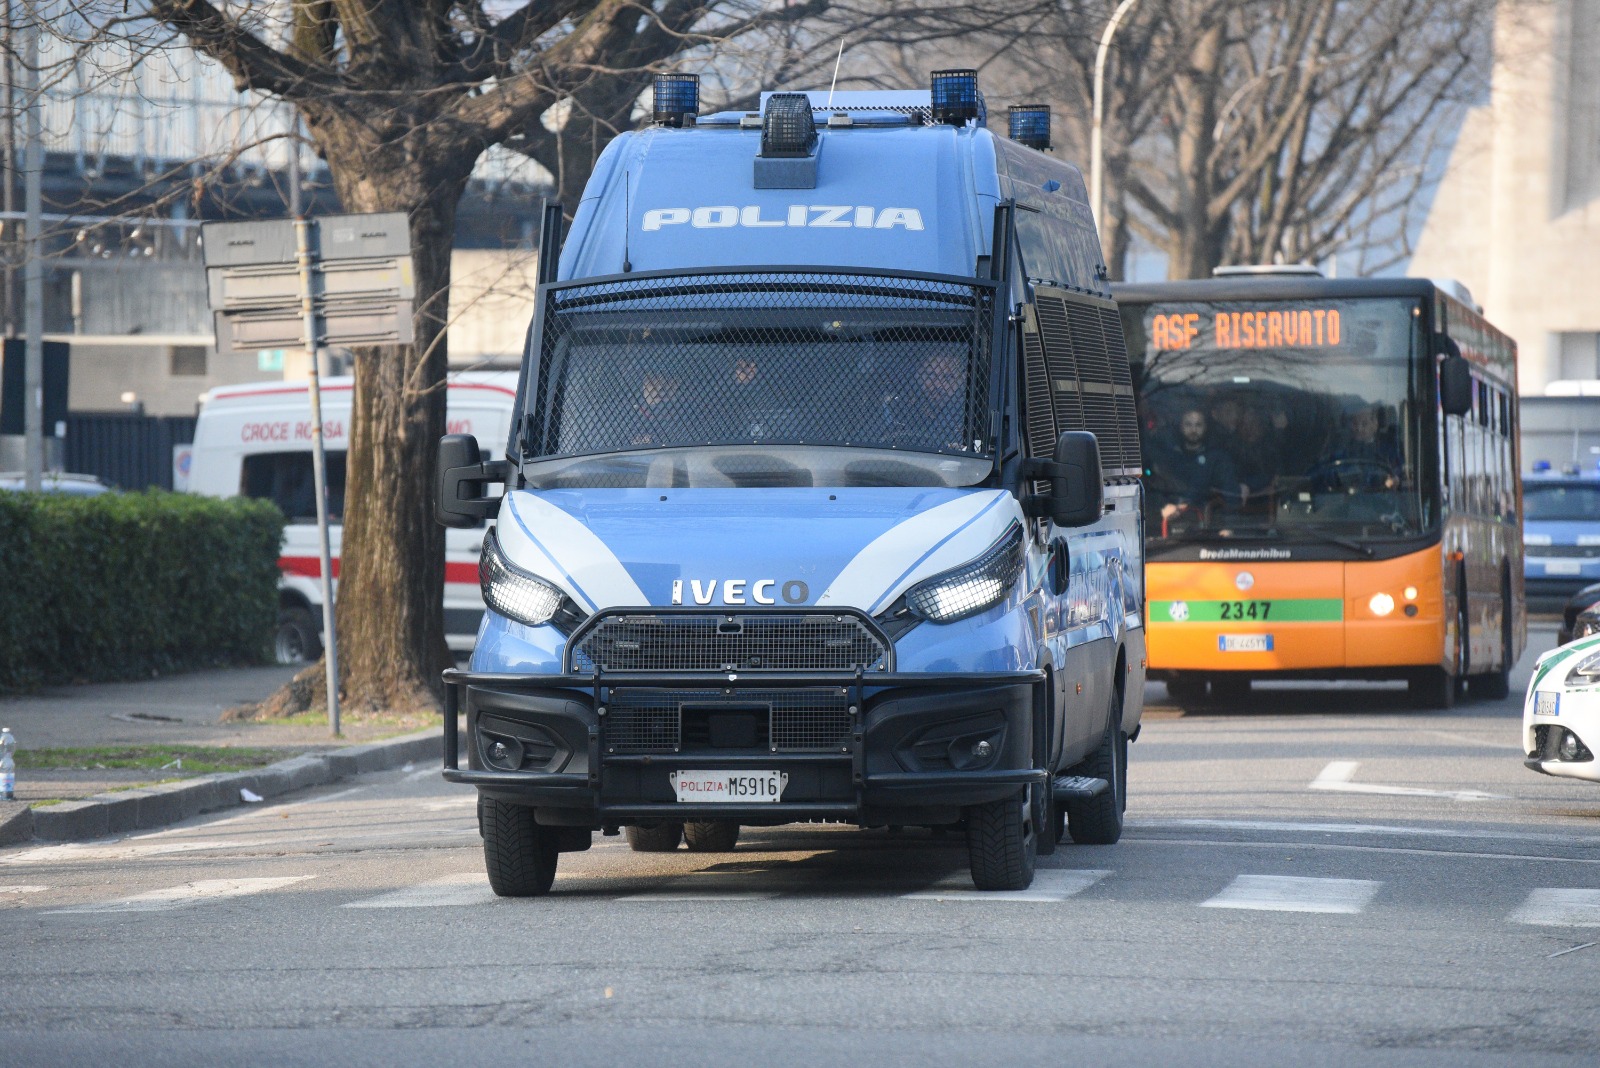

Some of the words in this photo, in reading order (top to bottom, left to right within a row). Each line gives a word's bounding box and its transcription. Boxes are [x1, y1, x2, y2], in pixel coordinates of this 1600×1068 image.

[642, 205, 925, 231] POLIZIA
[1153, 313, 1199, 349] ASF
[1215, 309, 1340, 348] RISERVATO
[241, 422, 289, 442] CROCE
[672, 579, 810, 605] IVECO
[1220, 601, 1271, 620] 2347
[681, 781, 724, 792] POLIZIA
[728, 777, 777, 796] M5916
